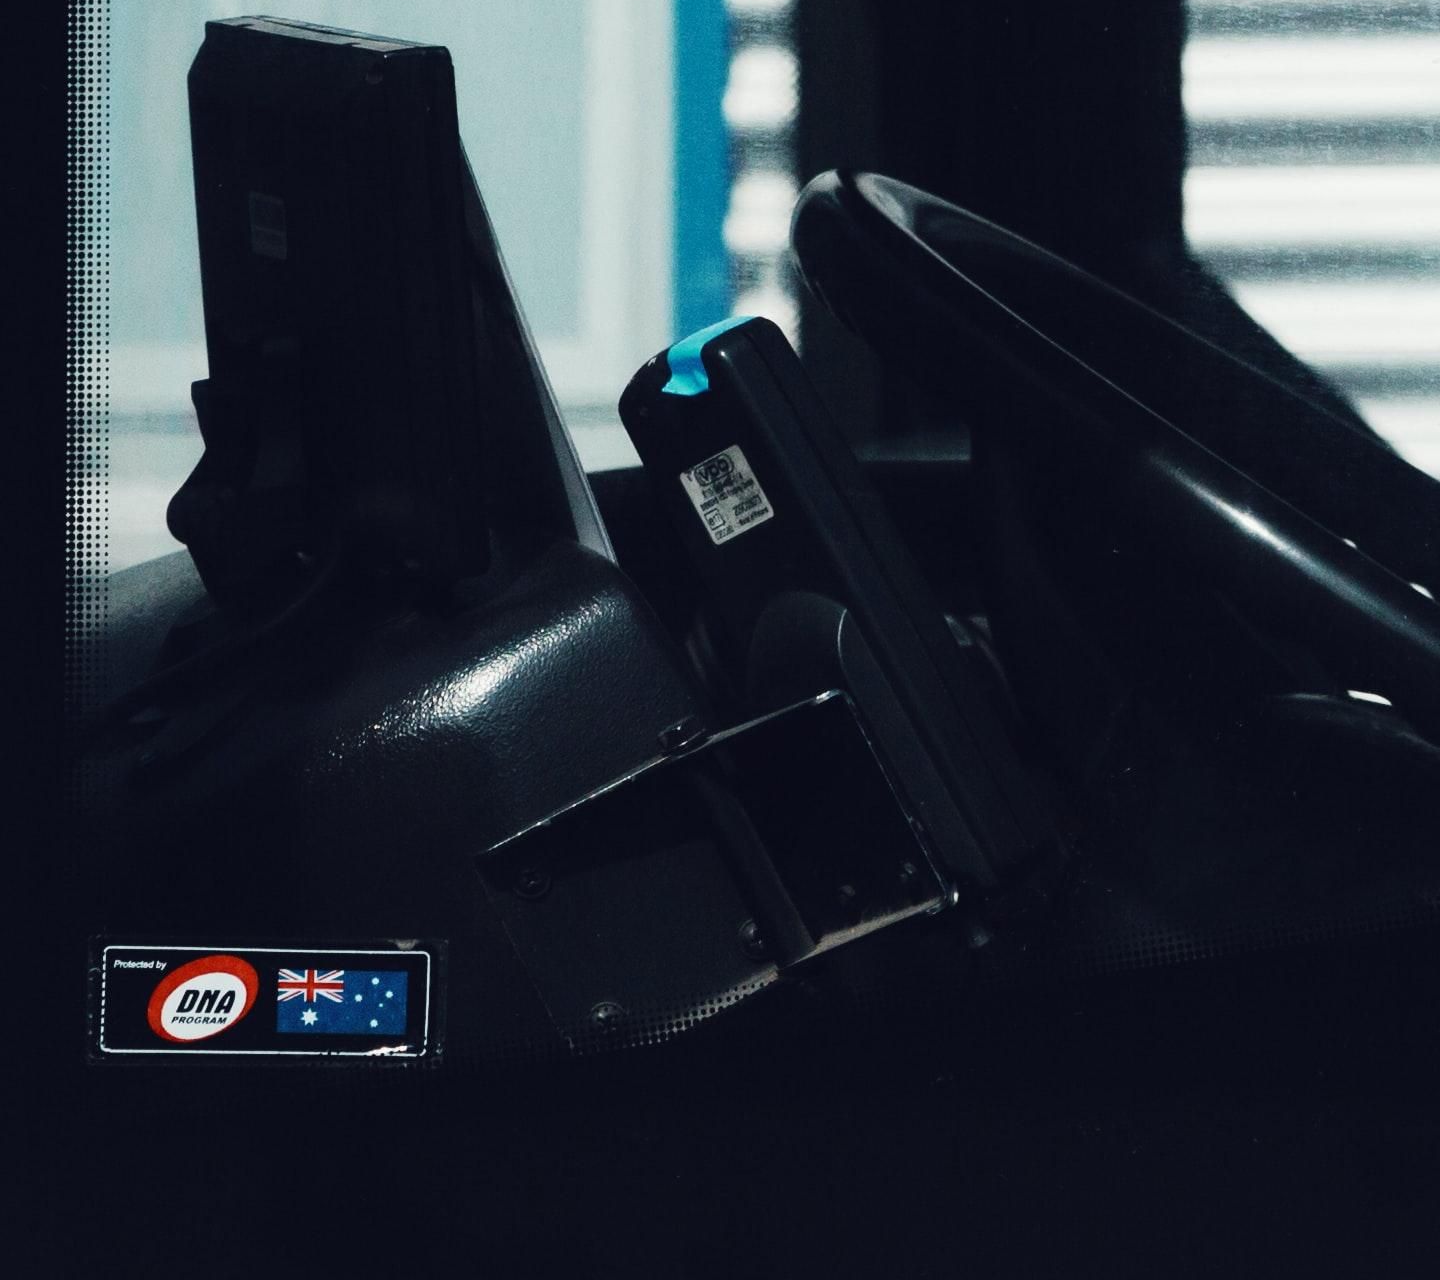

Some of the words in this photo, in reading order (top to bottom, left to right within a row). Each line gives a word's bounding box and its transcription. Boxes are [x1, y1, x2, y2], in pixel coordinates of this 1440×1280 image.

[697, 458, 731, 483] VDO
[114, 960, 153, 969] Protected
[156, 960, 166, 970] by
[176, 990, 236, 1013] DNA
[171, 1016, 227, 1024] PROGRAM
